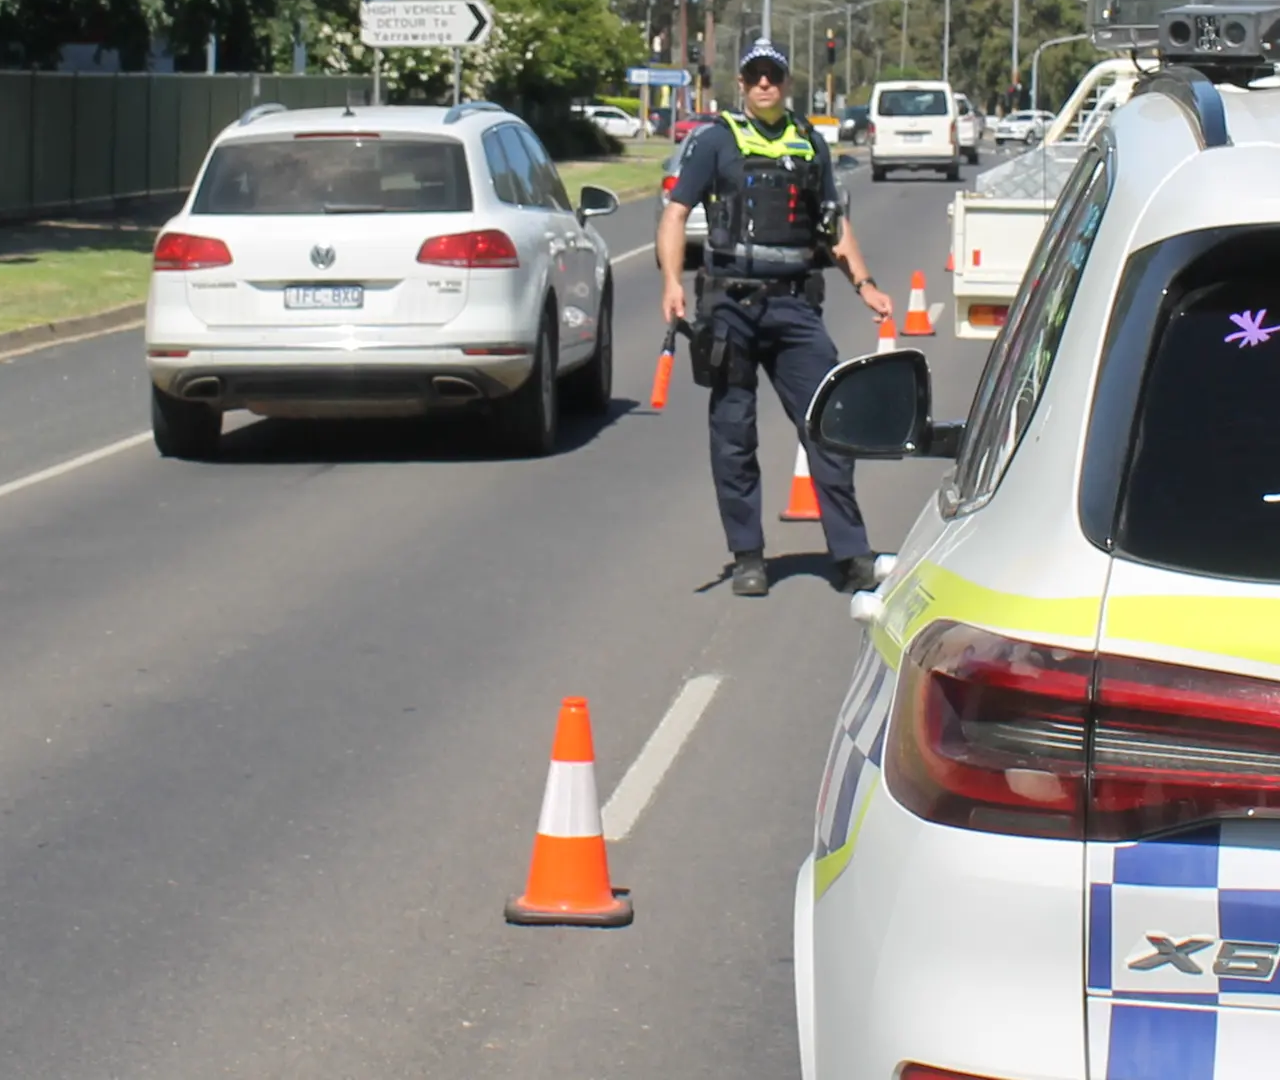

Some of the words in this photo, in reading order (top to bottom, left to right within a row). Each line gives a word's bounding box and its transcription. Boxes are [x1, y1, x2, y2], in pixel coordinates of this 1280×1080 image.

[368, 5, 396, 15] HIGH
[403, 4, 456, 15] VEHICLE
[376, 18, 426, 29] DETOUR
